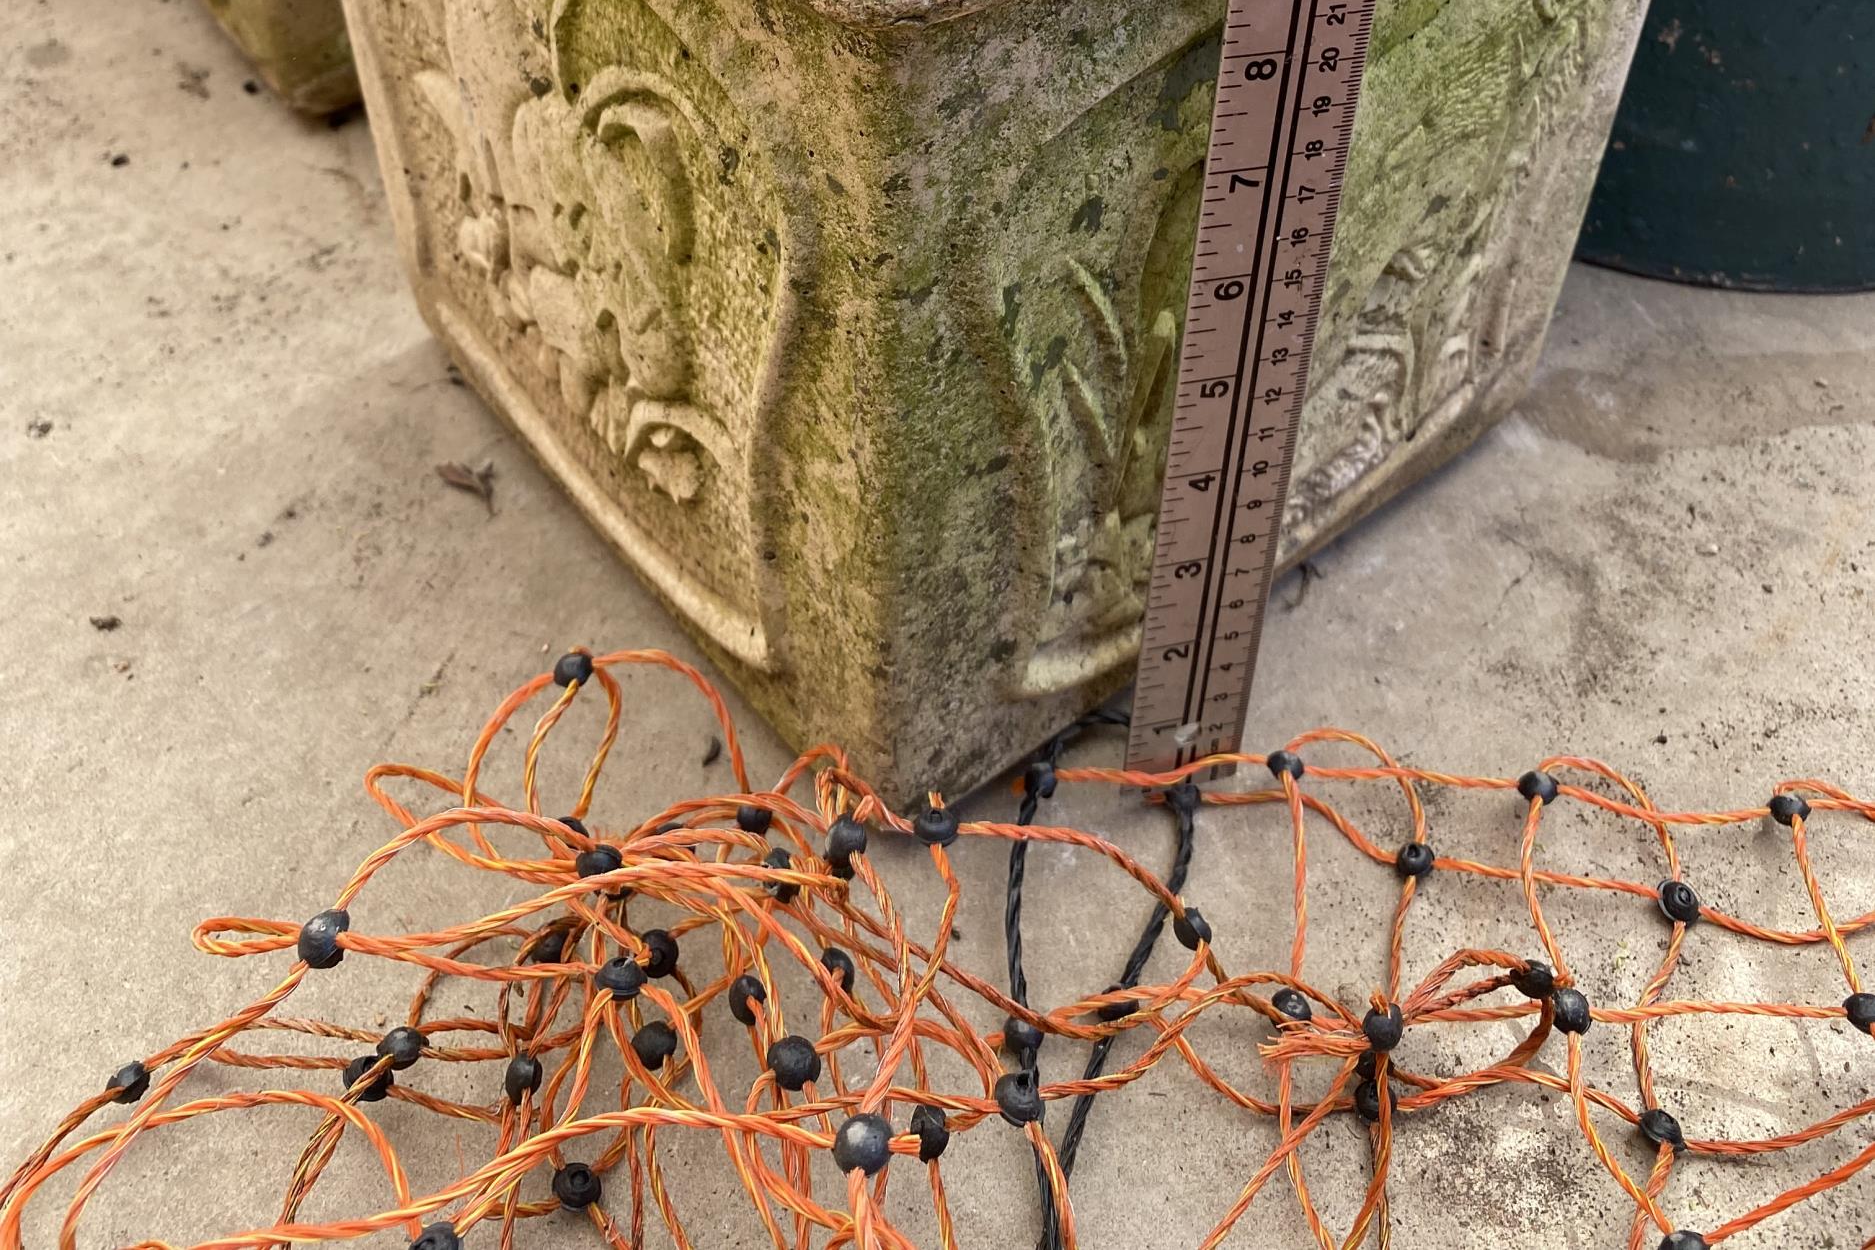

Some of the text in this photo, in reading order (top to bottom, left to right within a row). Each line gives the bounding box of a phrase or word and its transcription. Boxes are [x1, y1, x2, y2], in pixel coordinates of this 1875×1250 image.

[1326, 3, 1347, 26] 21
[1319, 47, 1339, 72] 20
[1245, 58, 1277, 81] 8
[1312, 95, 1332, 118] 19
[1305, 139, 1324, 161] 18
[1229, 174, 1260, 194] 7
[1297, 185, 1316, 204] 17
[1290, 227, 1310, 247] 16
[1284, 269, 1302, 289] 15
[1214, 280, 1245, 301] 6
[1277, 310, 1294, 328] 14
[1271, 348, 1289, 366] 13
[1200, 380, 1229, 399] 5
[1264, 387, 1282, 406] 12
[1259, 426, 1275, 442] 11
[1252, 460, 1269, 478] 10
[1188, 474, 1216, 492] 4
[1246, 499, 1263, 511] 9
[1240, 533, 1256, 545] 8
[1175, 562, 1202, 579] 3
[1235, 567, 1250, 578] 7
[1229, 598, 1244, 609] 6
[1224, 630, 1239, 641] 5
[1162, 644, 1190, 661] 2
[1219, 663, 1234, 672] 4
[1213, 692, 1228, 702] 3
[1152, 723, 1177, 735] 1
[1208, 722, 1223, 732] 2
